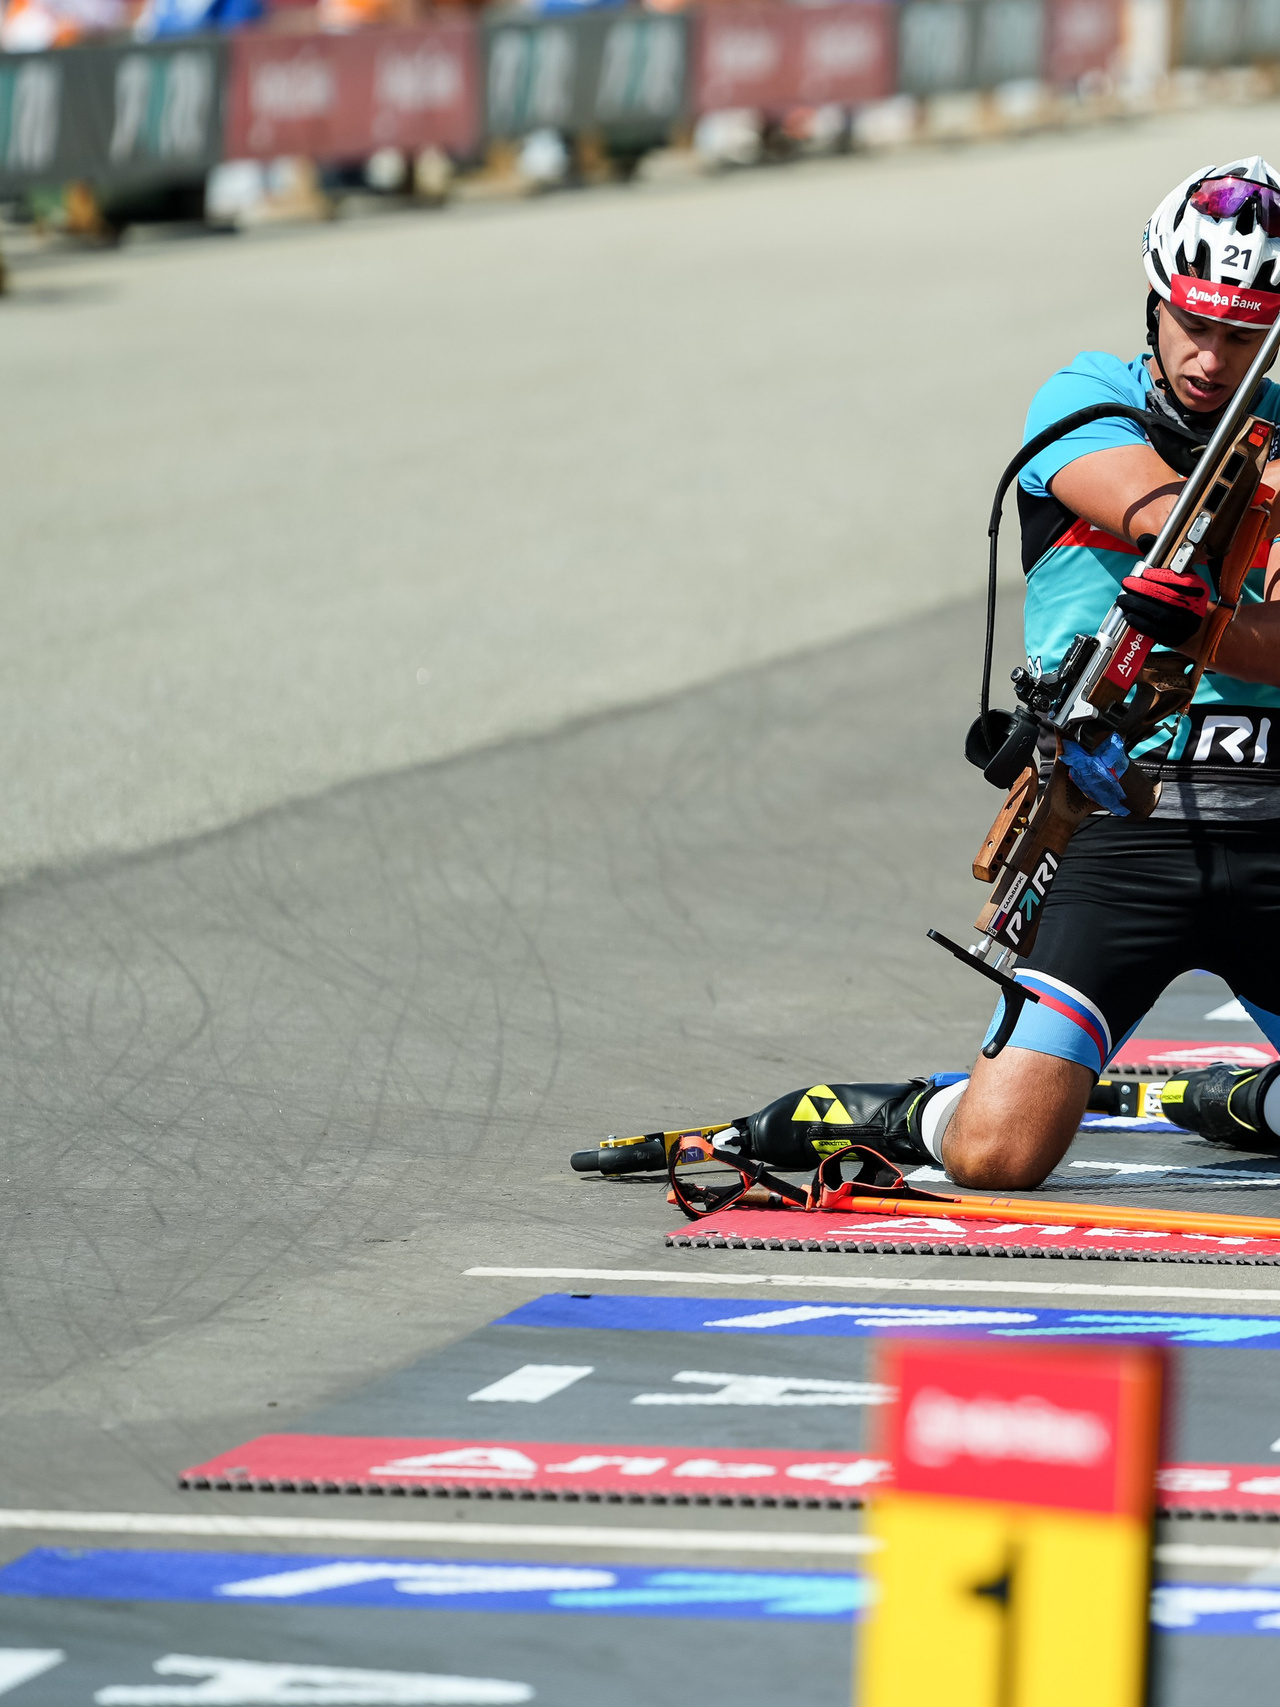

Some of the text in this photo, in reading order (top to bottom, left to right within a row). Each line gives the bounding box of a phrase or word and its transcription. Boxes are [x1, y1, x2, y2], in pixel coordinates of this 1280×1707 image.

[1221, 245, 1252, 270] 21
[1187, 286, 1261, 311] Альфа Банк
[1117, 633, 1145, 676] Альфа
[1128, 713, 1272, 763] ARI
[1003, 875, 1024, 909] САЛЬВАРЭС
[1005, 852, 1058, 945] PARI
[966, 1543, 1027, 1707] 1
